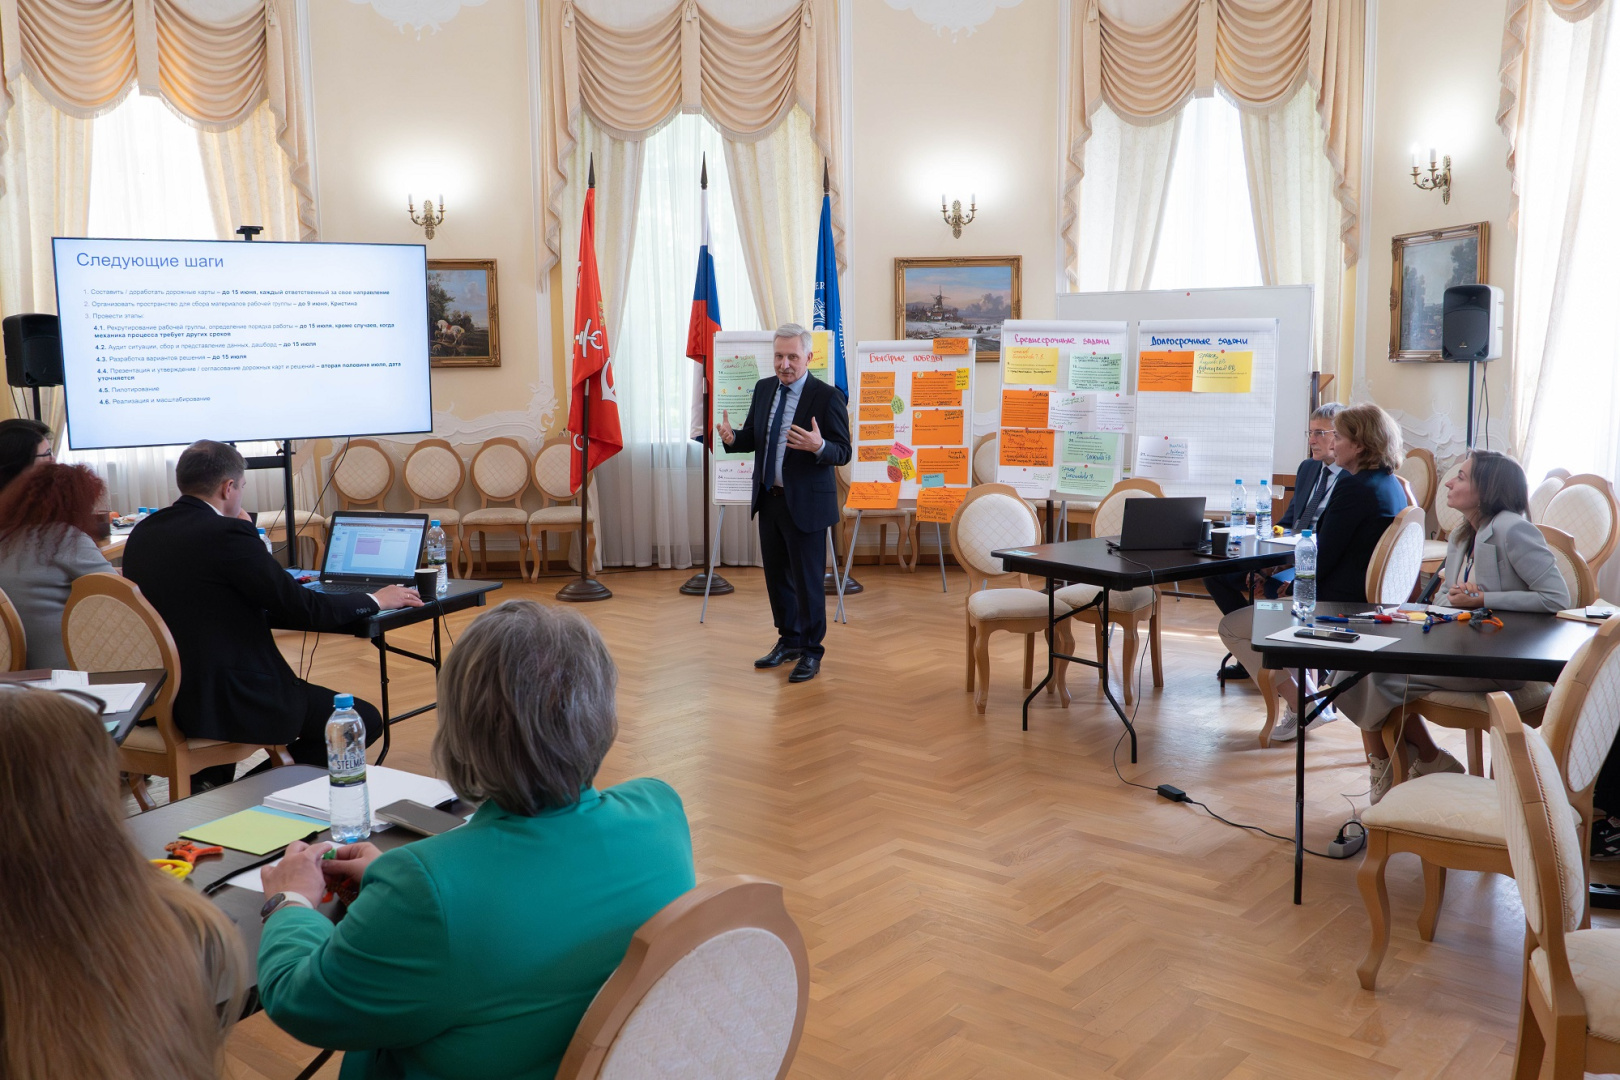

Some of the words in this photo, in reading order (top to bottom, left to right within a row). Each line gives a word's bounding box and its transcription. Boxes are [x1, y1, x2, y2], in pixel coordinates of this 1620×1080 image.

[76, 252, 179, 269] Следующие
[184, 257, 224, 267] шаги
[1014, 334, 1077, 346] Среднесрочные
[1150, 336, 1212, 348] Долгосрочные
[869, 353, 907, 364] Быстрые
[913, 354, 943, 362] победы
